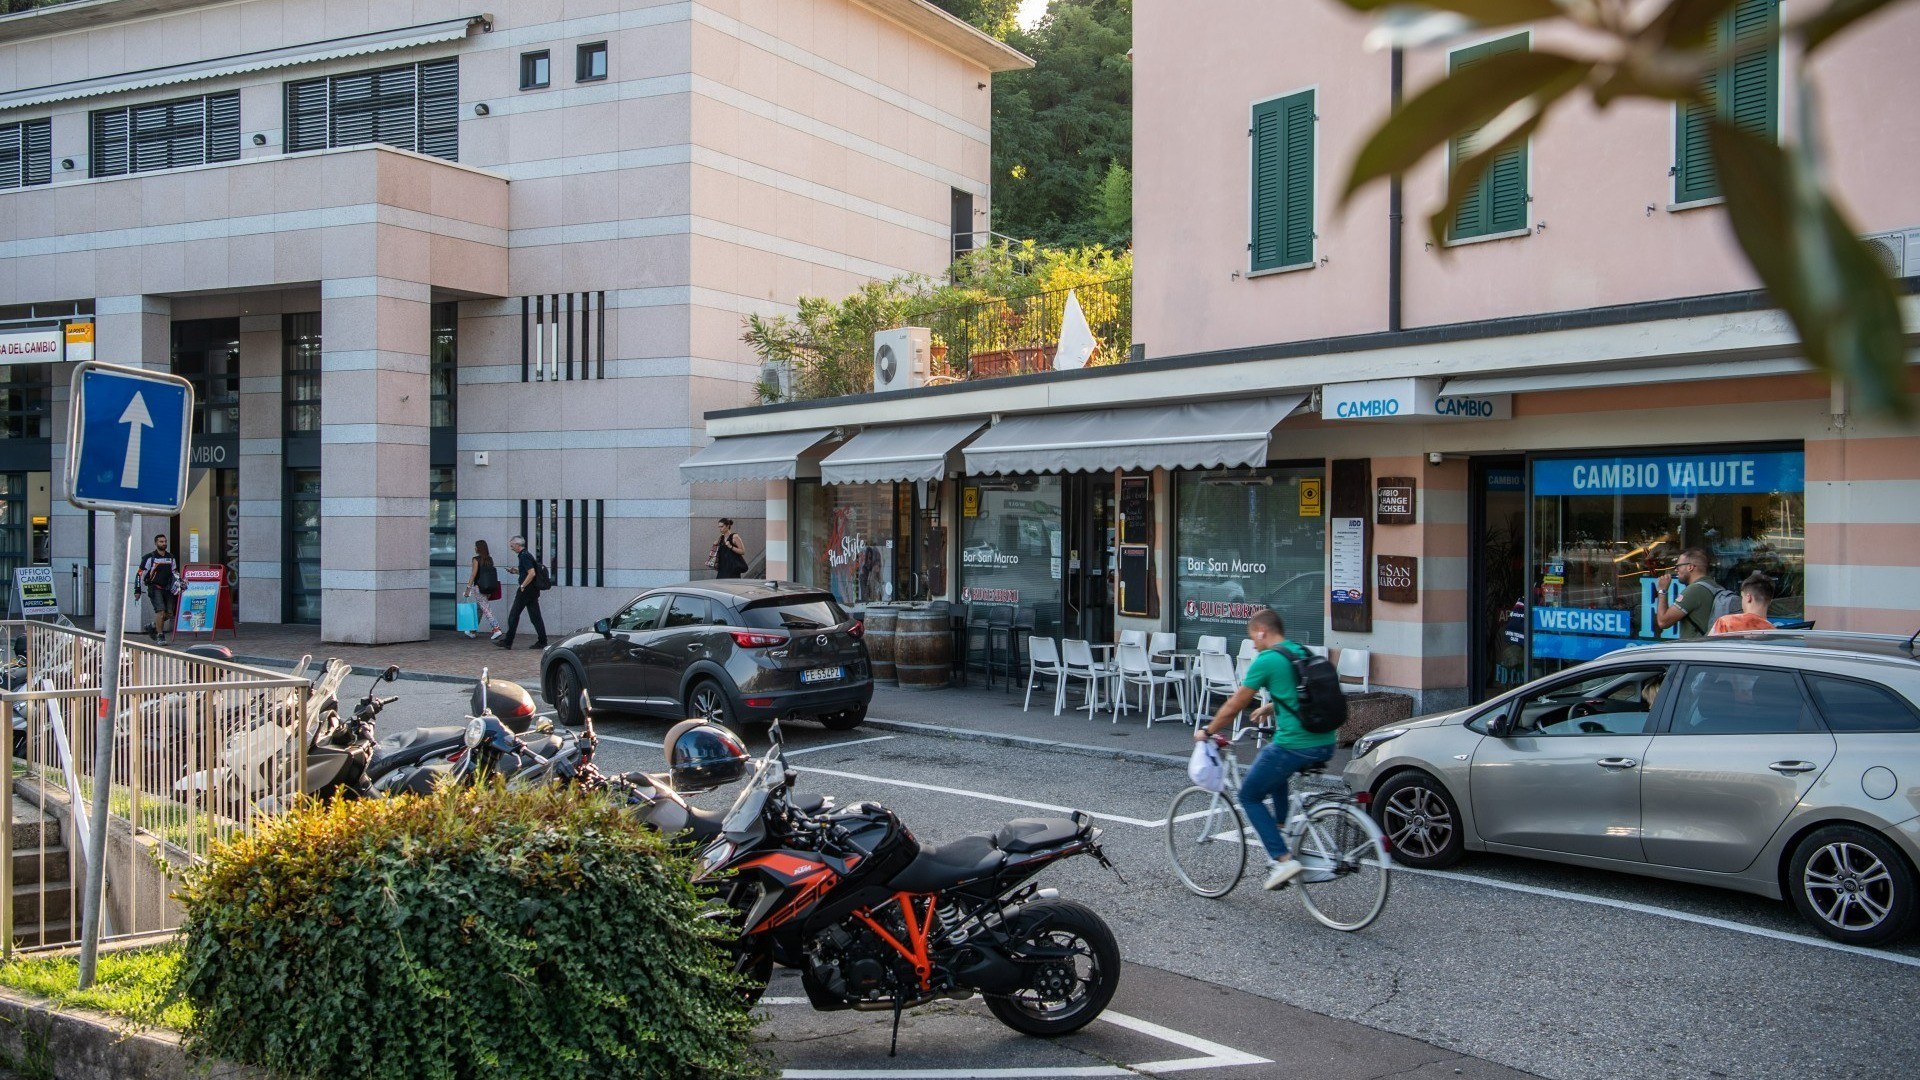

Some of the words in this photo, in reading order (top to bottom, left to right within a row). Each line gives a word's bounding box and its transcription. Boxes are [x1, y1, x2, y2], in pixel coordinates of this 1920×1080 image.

[9, 343, 23, 354] DEL
[25, 341, 57, 353] CAMBIO
[1337, 399, 1399, 418] CAMBIO
[1435, 399, 1493, 417] CAMBIO
[1488, 475, 1521, 485] CAMBIO
[1572, 463, 1659, 489] CAMBIO
[1667, 460, 1755, 487] VALUTE
[227, 504, 240, 586] CAMBIO
[829, 549, 847, 567] Hair
[842, 533, 866, 562] Style
[963, 550, 976, 563] Bar
[977, 550, 992, 563] San
[994, 552, 1019, 564] Marco
[20, 568, 51, 576] UFFICIO
[1187, 557, 1206, 571] Bar
[1208, 557, 1228, 572] San
[1231, 558, 1266, 573] Marco
[1386, 563, 1410, 577] SAN
[21, 575, 52, 583] CAMBIO
[1539, 609, 1627, 632] WECHSEL
[805, 670, 815, 680] FE
[817, 667, 840, 679] 534PZ
[794, 865, 812, 875] KTM
